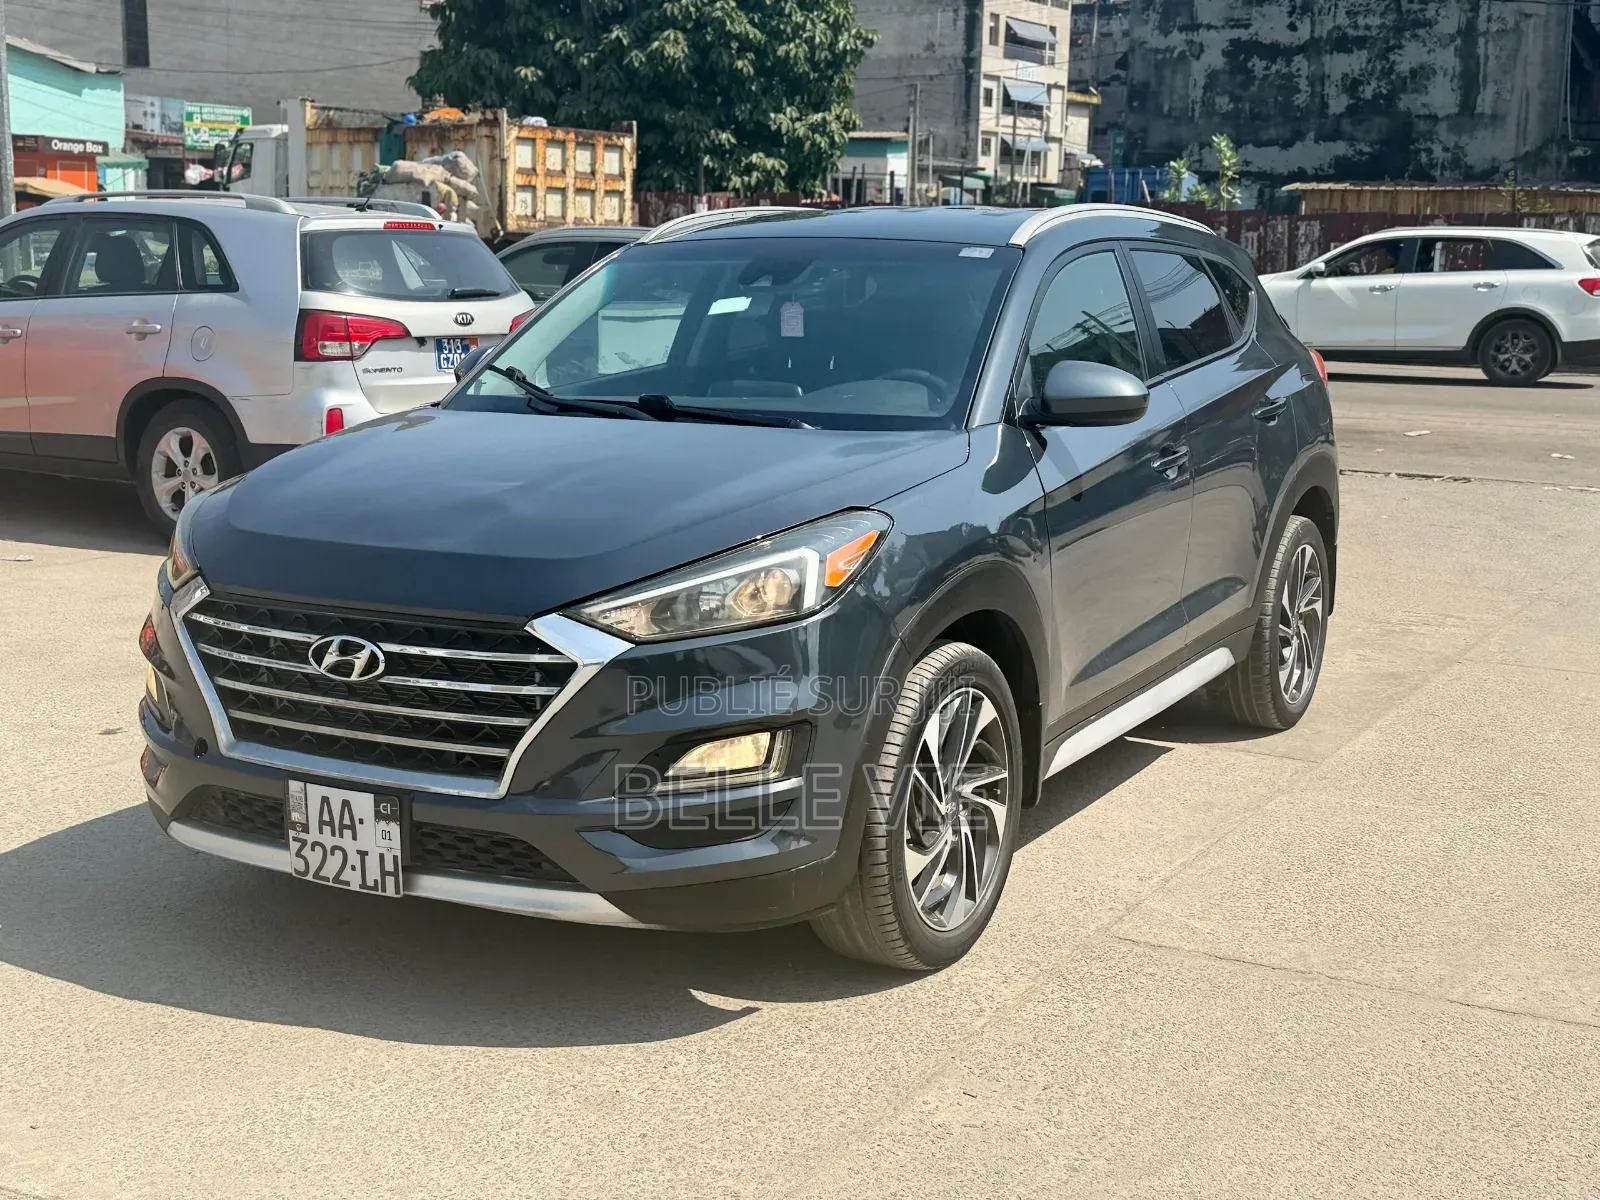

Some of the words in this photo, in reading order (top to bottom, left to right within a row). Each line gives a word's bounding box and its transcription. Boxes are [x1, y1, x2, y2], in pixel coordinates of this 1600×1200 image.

[51, 139, 84, 154] Orange
[85, 141, 104, 153] Box
[455, 314, 473, 325] KIA
[442, 338, 462, 353] 313
[381, 829, 392, 841] 01
